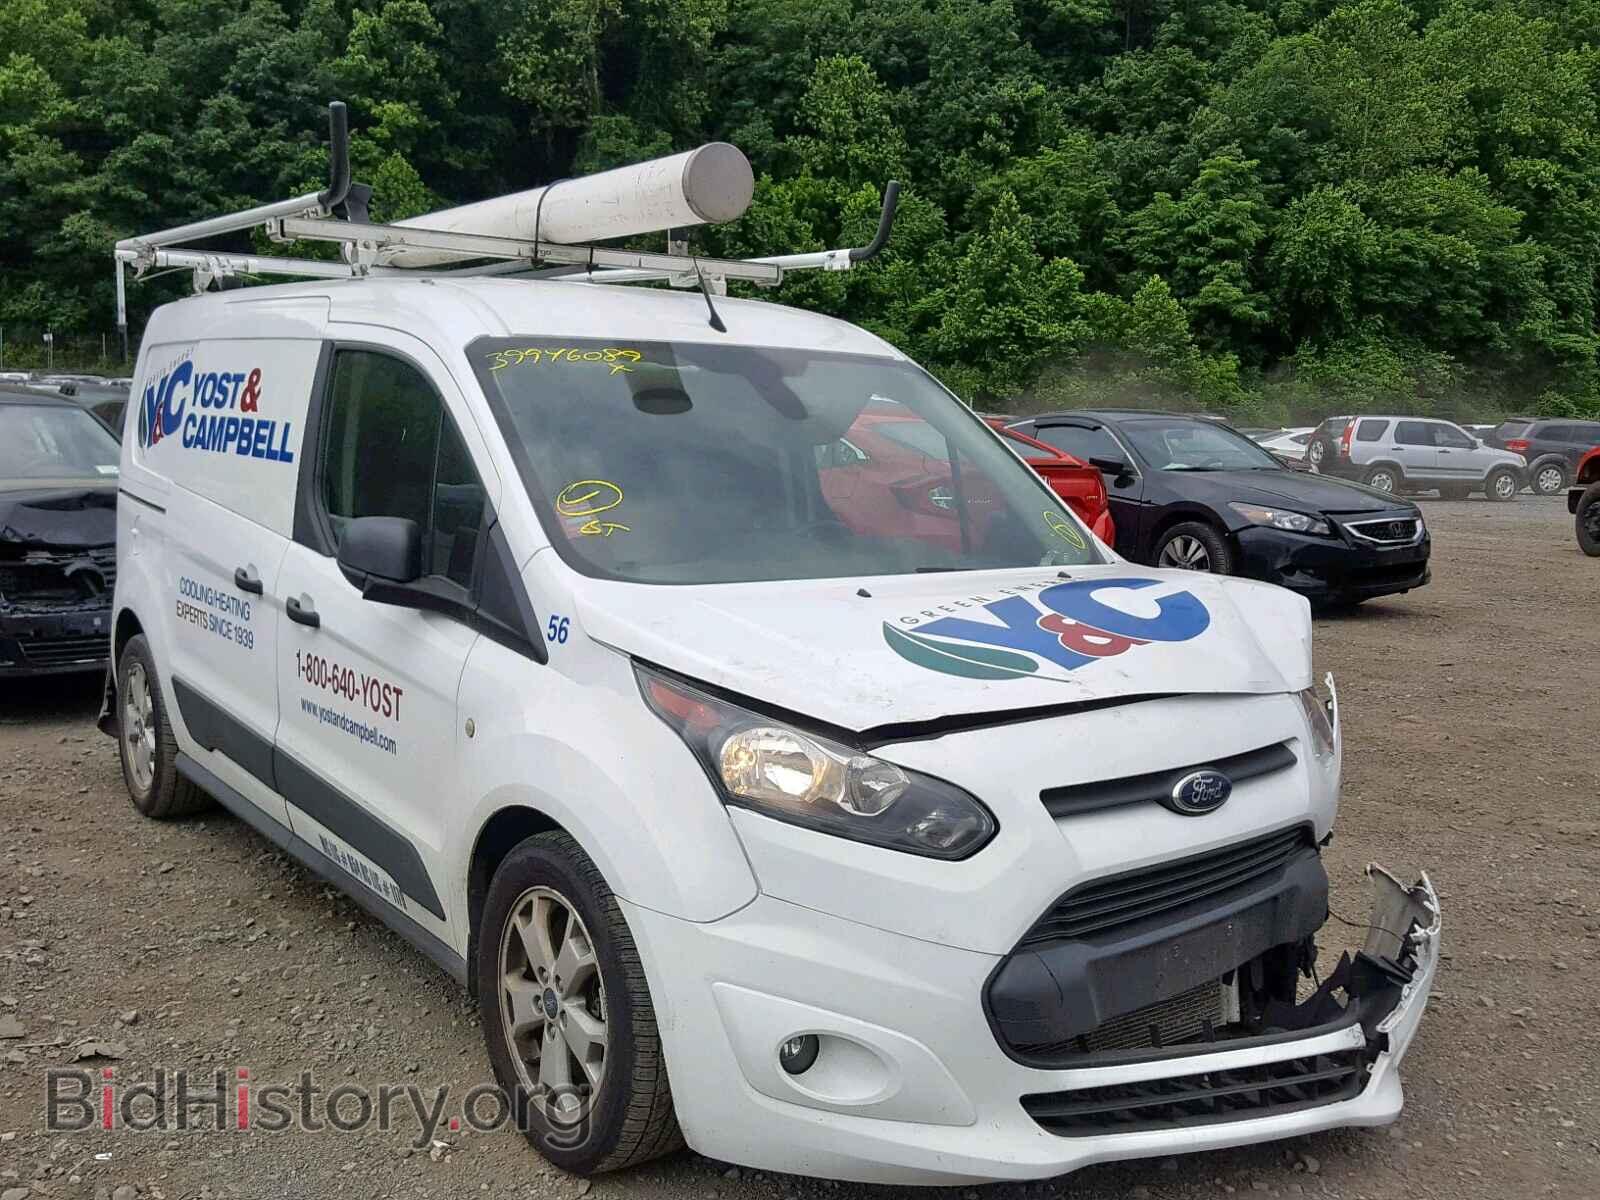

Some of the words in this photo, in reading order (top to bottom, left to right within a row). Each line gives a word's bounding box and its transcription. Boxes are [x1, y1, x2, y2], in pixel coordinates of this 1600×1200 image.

[182, 413, 294, 463] CAMPBELL
[180, 576, 251, 621] COOLING/HEATING
[899, 595, 992, 625] GREEN
[176, 600, 208, 630] EXPERTS
[209, 614, 233, 640] SINCE
[234, 624, 254, 650] 1939
[547, 614, 570, 644] 56
[296, 648, 403, 722] 1-800-640-YOST
[300, 697, 397, 756] www.yostandcampbell.com
[1191, 775, 1223, 803] Ford
